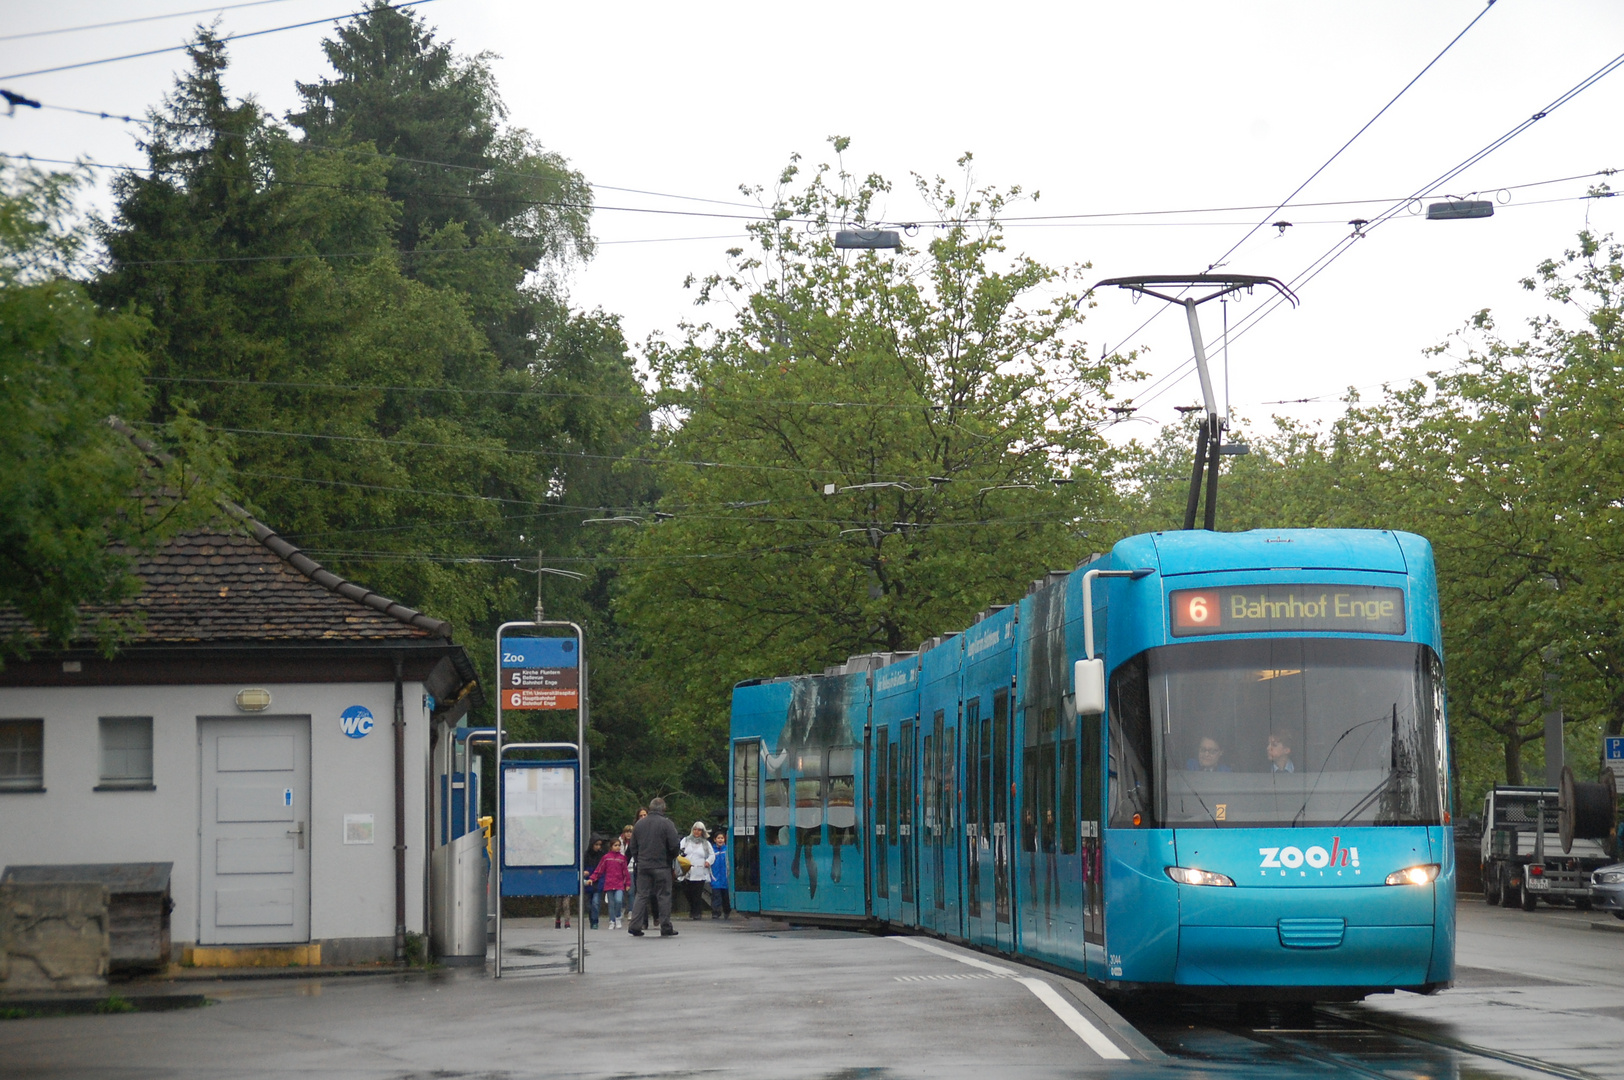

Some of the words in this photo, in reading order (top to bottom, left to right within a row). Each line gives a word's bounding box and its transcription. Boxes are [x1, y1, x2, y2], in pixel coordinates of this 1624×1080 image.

[1189, 596, 1208, 622] 6
[1231, 594, 1327, 619] Bahnhof
[1334, 594, 1394, 620] Enge
[503, 653, 525, 663] Zoo
[511, 673, 521, 685] 5
[511, 693, 521, 706] 6
[340, 717, 373, 734] WC
[1612, 740, 1620, 750] P
[1217, 806, 1224, 818] 2
